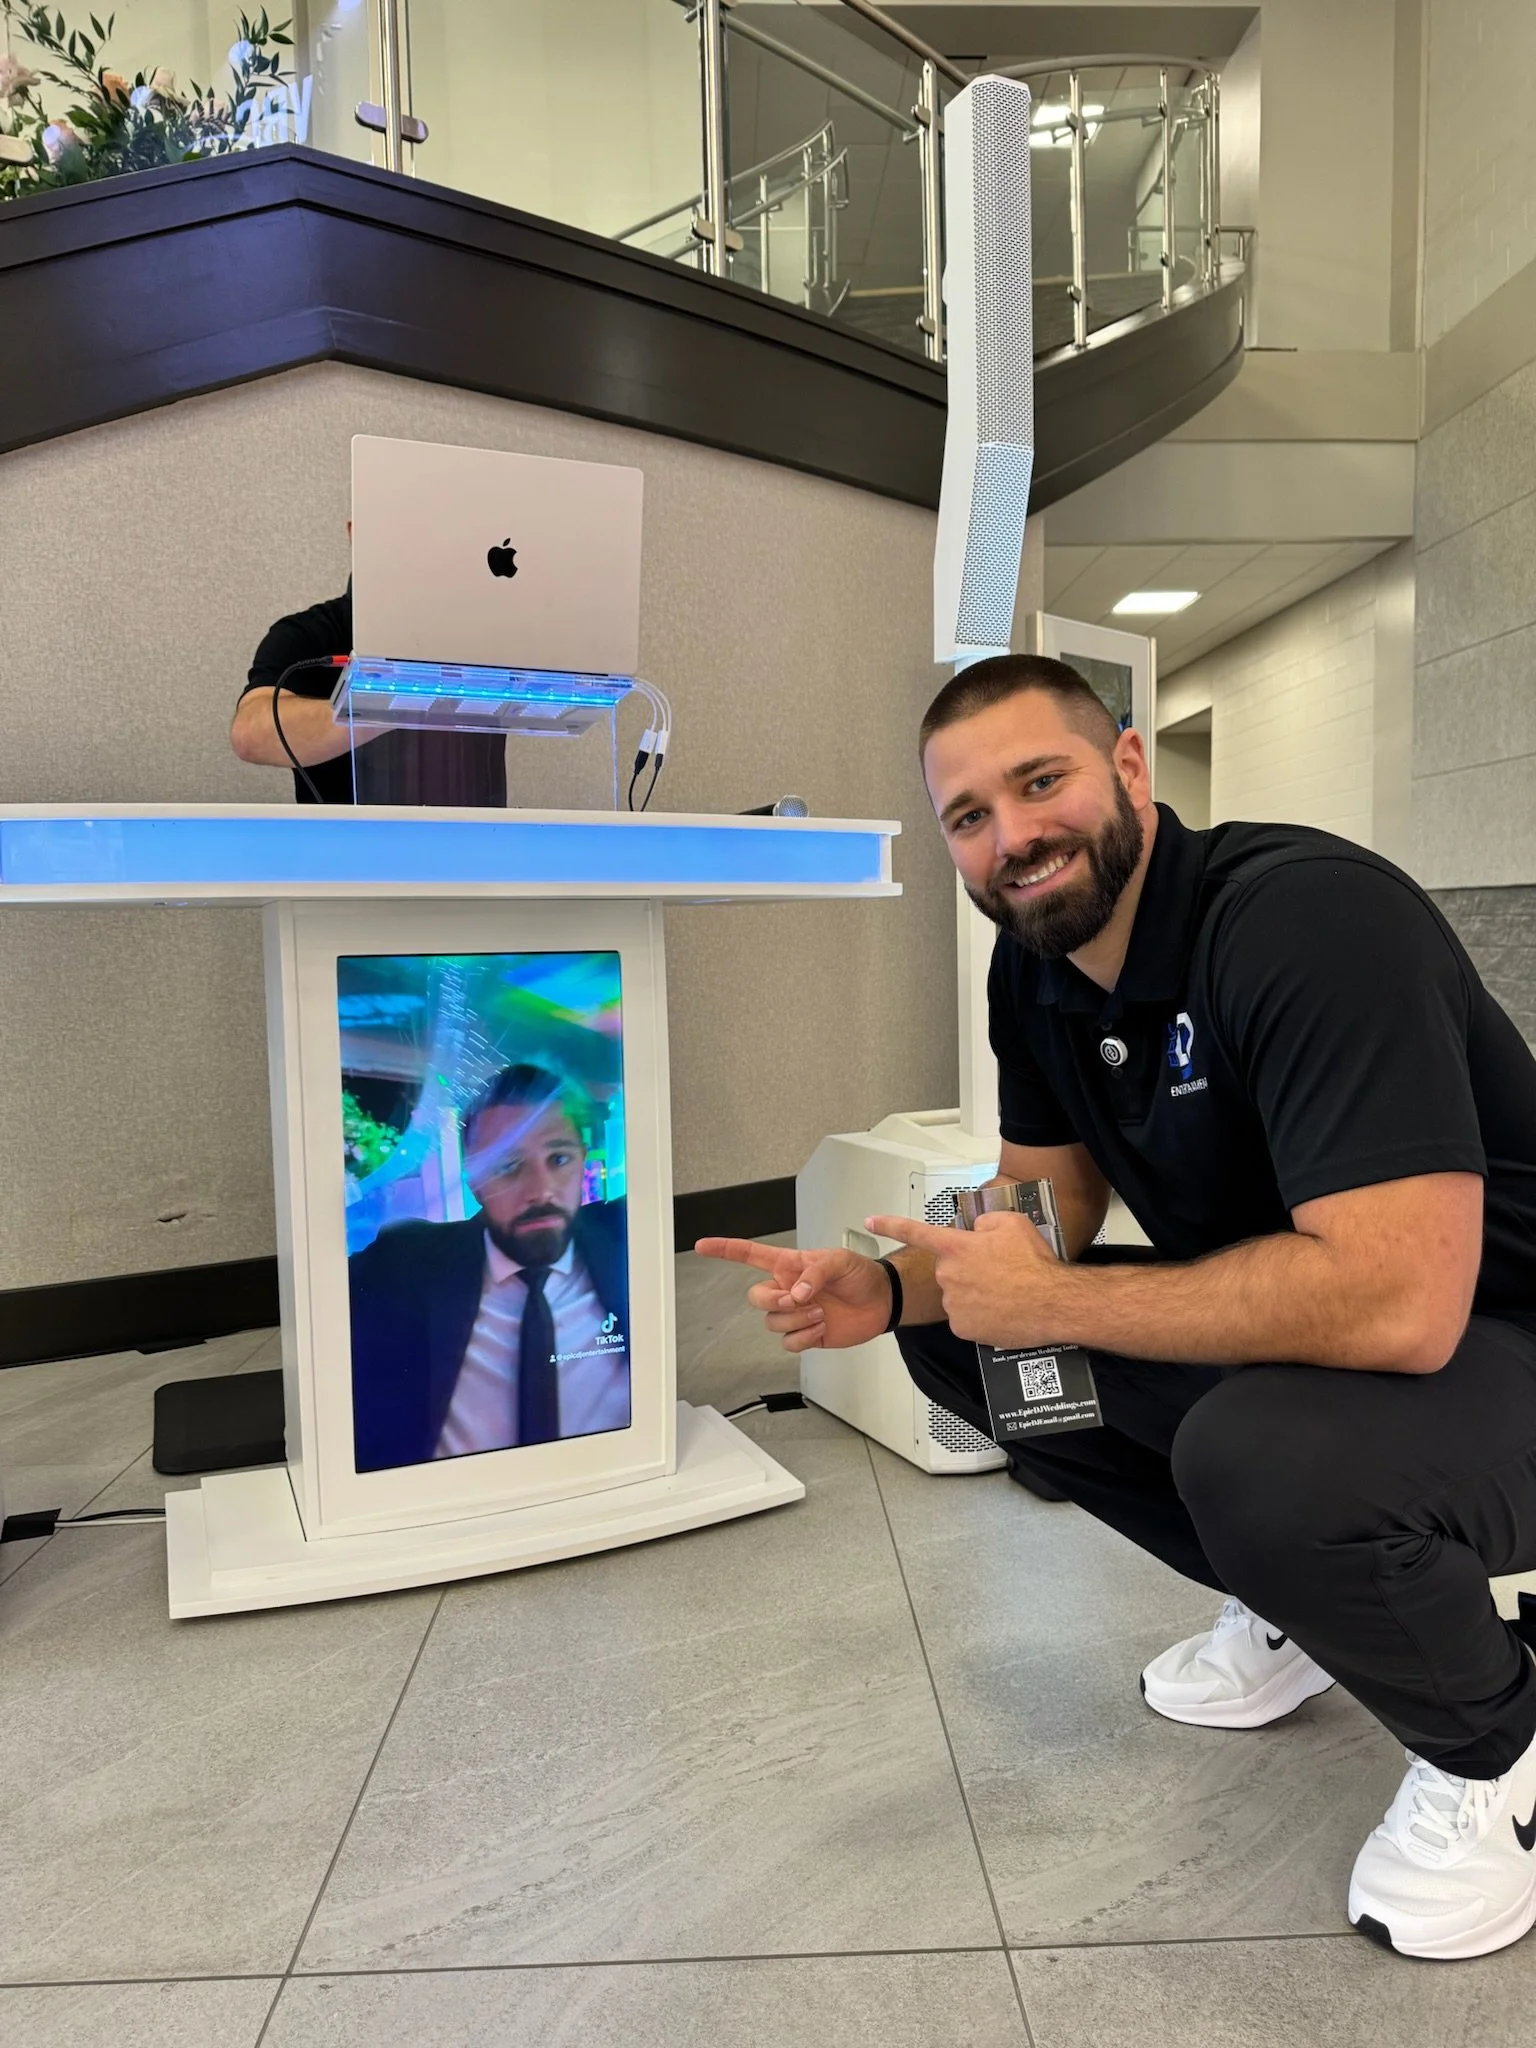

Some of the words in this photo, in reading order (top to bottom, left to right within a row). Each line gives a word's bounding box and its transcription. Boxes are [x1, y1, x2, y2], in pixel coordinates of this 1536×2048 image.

[595, 1334, 624, 1345] TikTok
[998, 1399, 1096, 1420] www.EpicDJWeddings.com
[1018, 1412, 1095, 1429] EpicDJEmail@gmail.com
